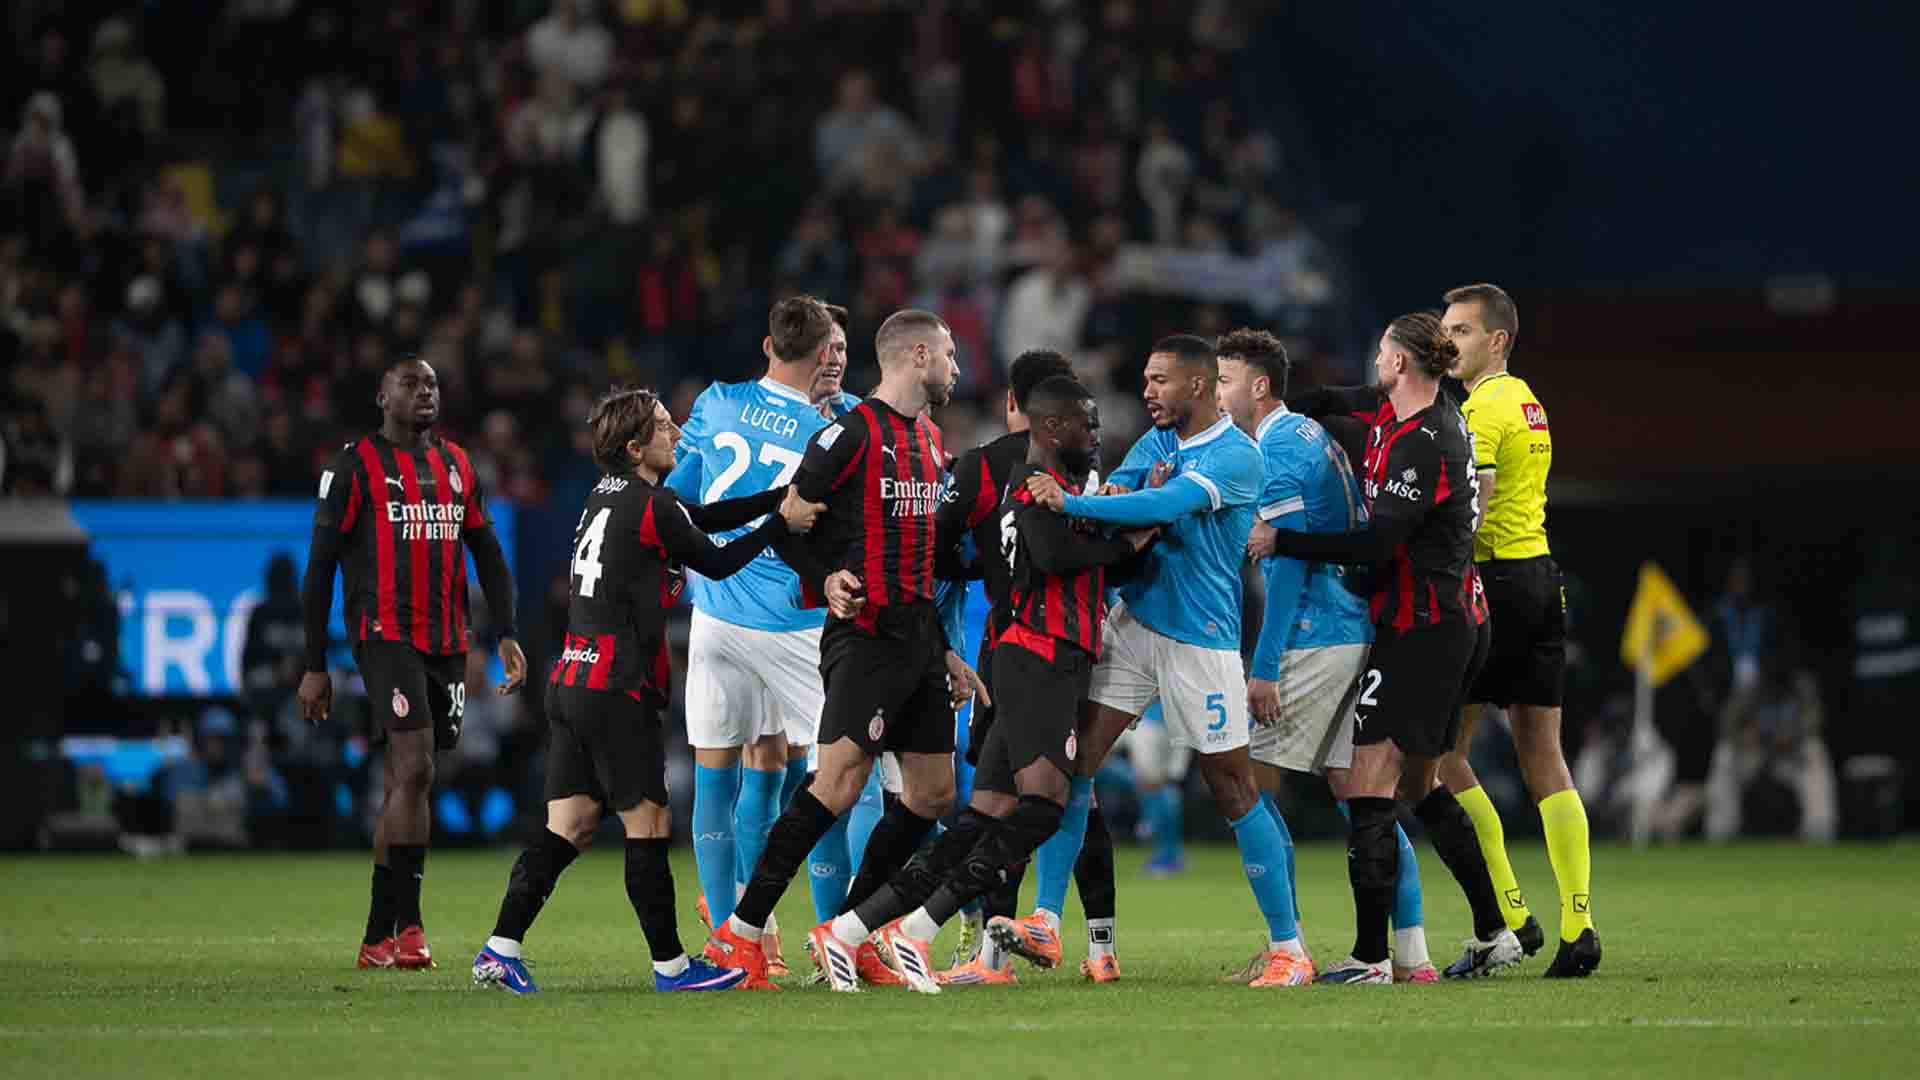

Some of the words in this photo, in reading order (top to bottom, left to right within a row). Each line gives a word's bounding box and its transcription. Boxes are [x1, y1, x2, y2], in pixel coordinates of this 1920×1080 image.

[740, 402, 798, 439] LUCCA
[704, 431, 804, 506] 27
[880, 476, 944, 500] Emirate
[1385, 479, 1421, 501] MSC
[385, 498, 465, 522] Emirate
[402, 522, 422, 540] FLY
[425, 522, 460, 541] BETTER
[1206, 693, 1227, 731] 5
